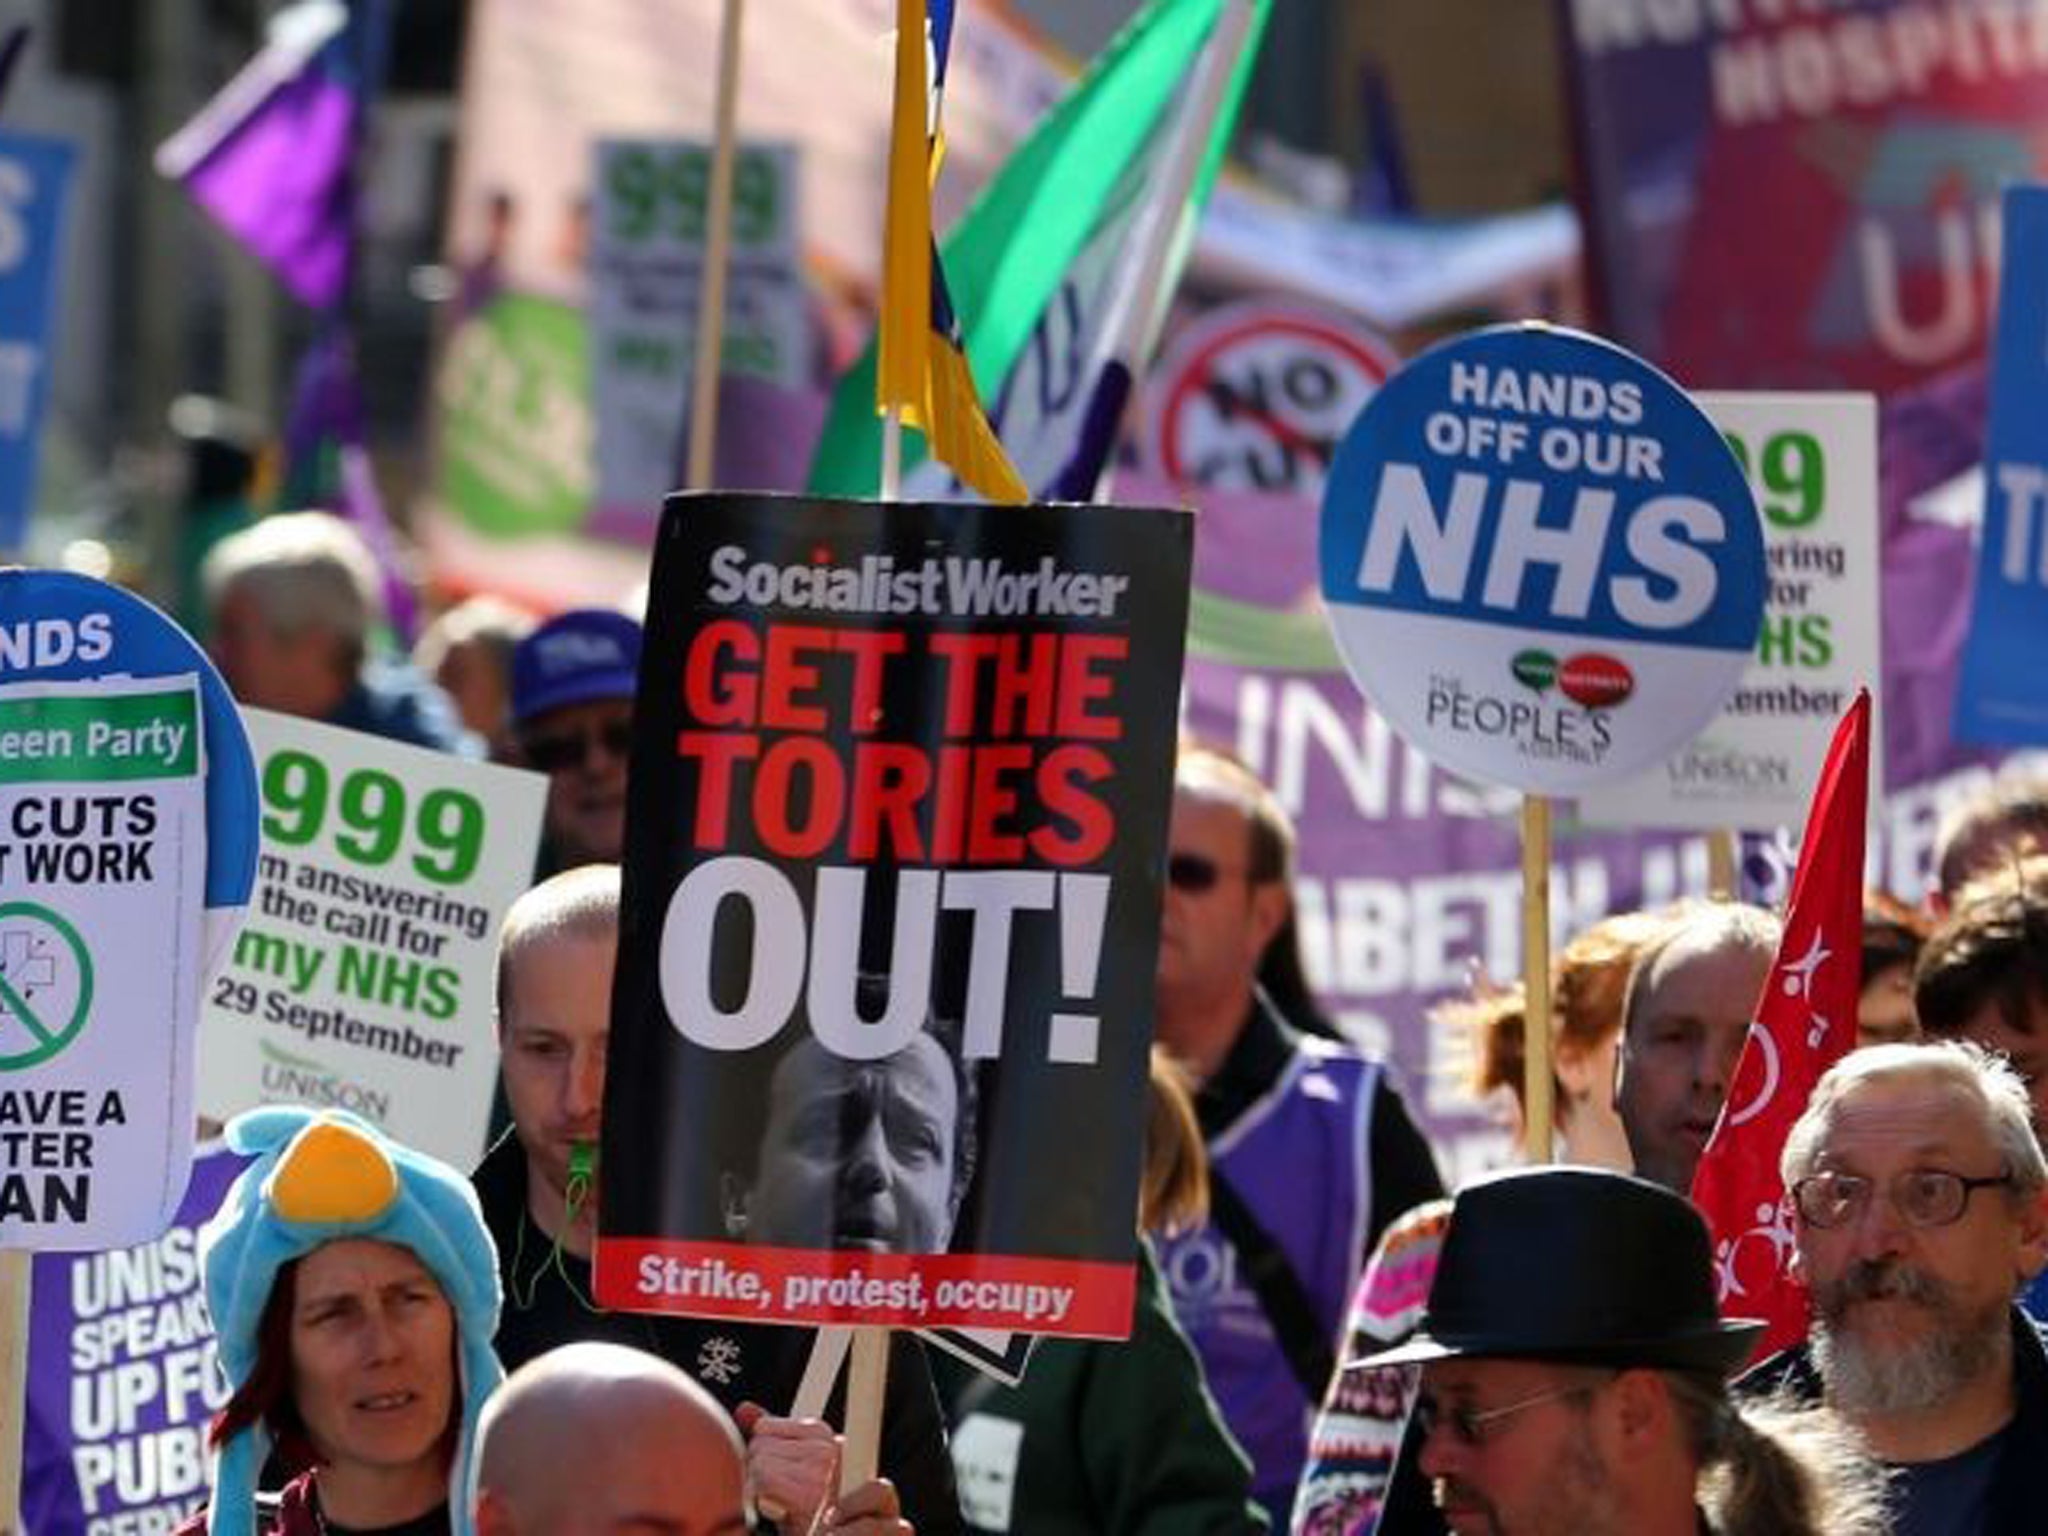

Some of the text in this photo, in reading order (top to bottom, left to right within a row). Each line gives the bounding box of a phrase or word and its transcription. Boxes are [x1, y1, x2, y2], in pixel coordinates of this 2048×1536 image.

[1451, 362, 1644, 425] HANDS
[1426, 412, 1665, 482] OFF OUR
[1357, 461, 1727, 629] NHS
[944, 555, 1129, 616] Worker
[684, 620, 907, 735] GET
[929, 634, 1130, 738] THE
[1726, 687, 1845, 715] ember
[87, 717, 187, 765] Party
[1426, 692, 1611, 750] PEOPLE'S
[12, 795, 157, 838] CUTS
[262, 750, 485, 885] 999
[677, 731, 1118, 867] TORIES
[25, 841, 154, 884] WORK
[261, 885, 449, 958] the call for
[296, 862, 490, 940] answering
[234, 929, 461, 1020] my NHS
[658, 856, 1112, 1064] OUT!
[212, 976, 464, 1068] 29 September
[96, 1089, 126, 1126] A
[2, 1132, 94, 1169] TER
[637, 1253, 1074, 1323] Strike, protest, occupy
[71, 1360, 158, 1440] UP
